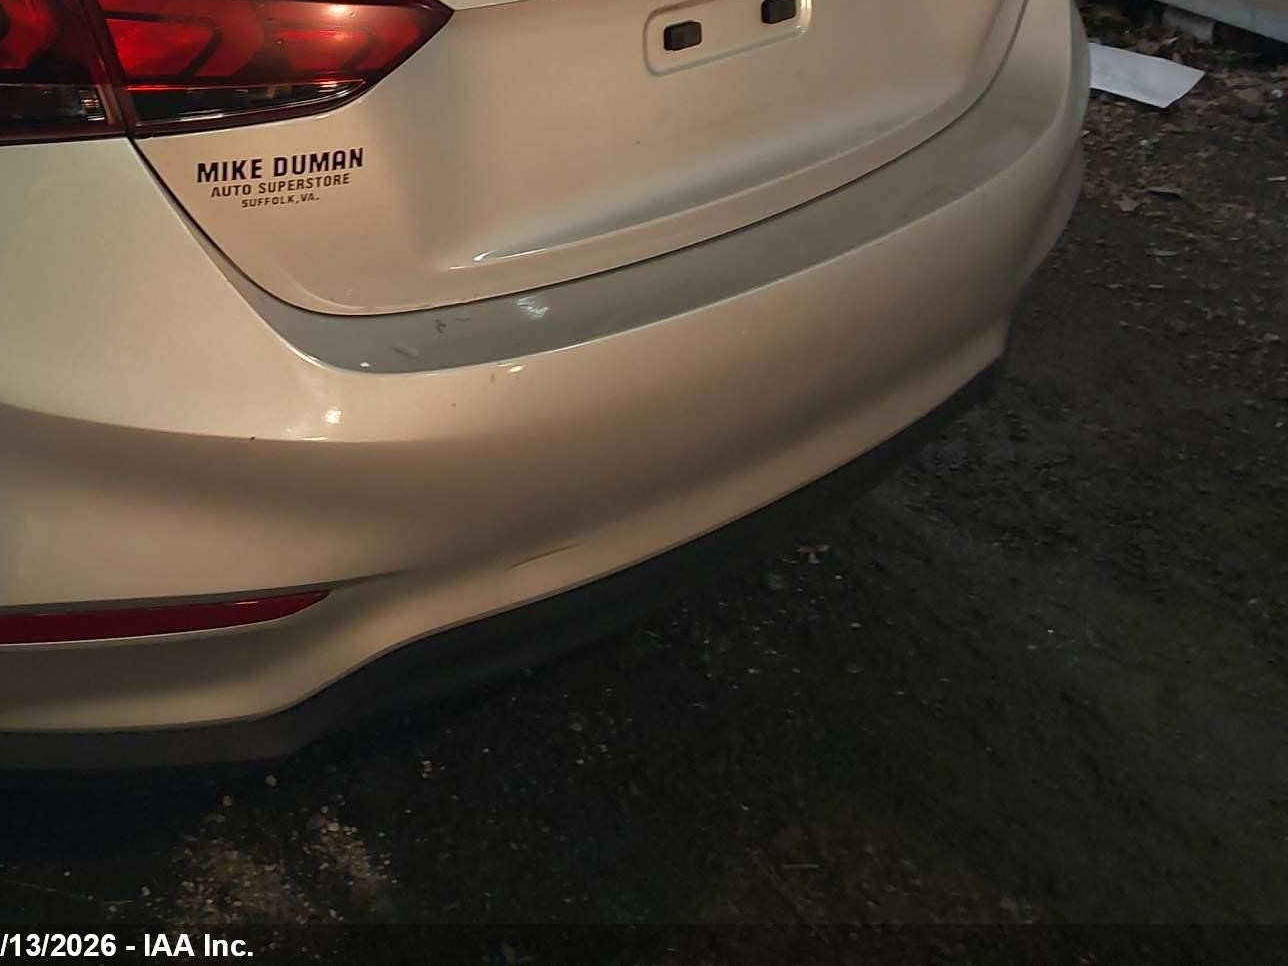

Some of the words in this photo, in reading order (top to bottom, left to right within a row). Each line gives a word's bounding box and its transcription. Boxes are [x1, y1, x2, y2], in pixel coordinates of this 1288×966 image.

[197, 159, 263, 183] MIKE
[273, 148, 364, 177] DUMAN
[211, 184, 251, 198] AUTO
[258, 173, 351, 194] SUPERSTORE
